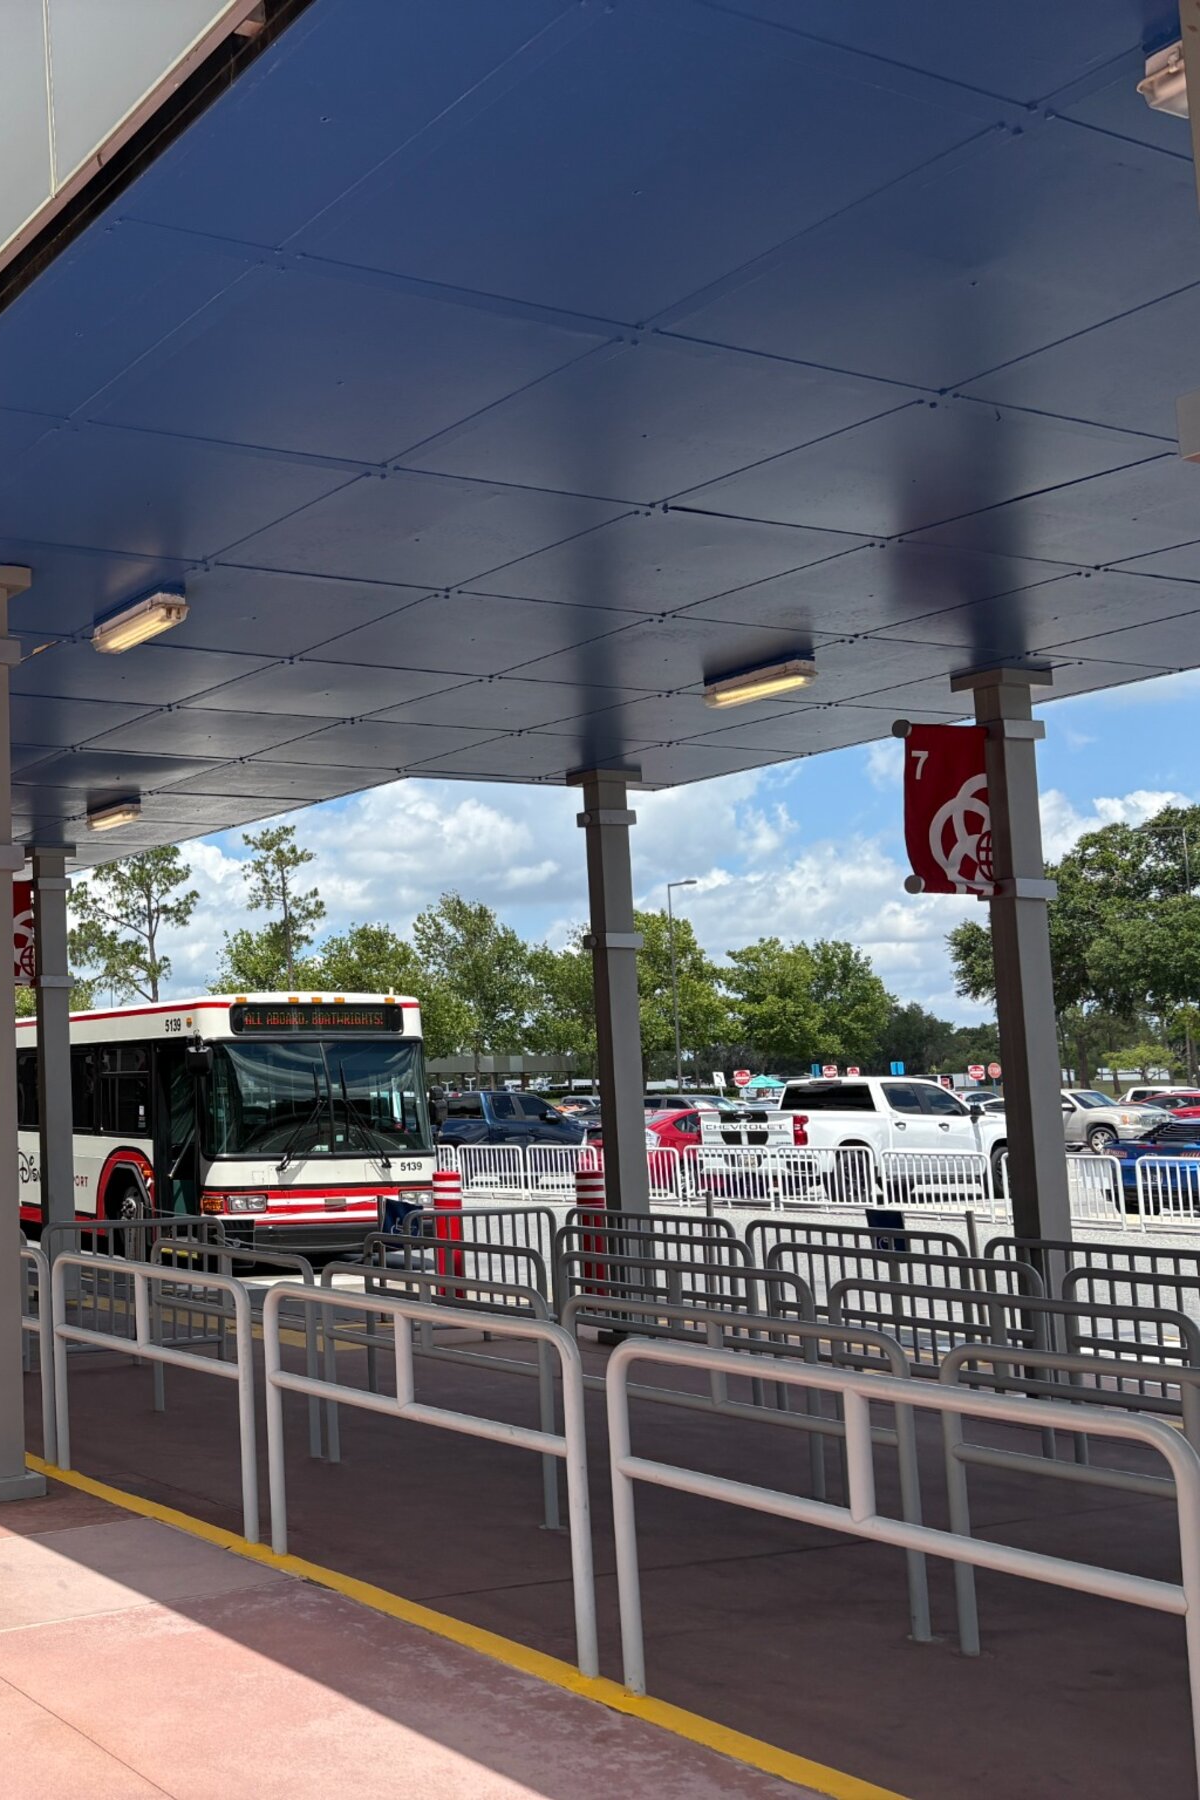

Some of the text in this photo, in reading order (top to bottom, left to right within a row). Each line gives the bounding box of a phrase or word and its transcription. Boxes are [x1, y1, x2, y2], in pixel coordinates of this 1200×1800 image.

[911, 750, 929, 780] 7
[165, 1017, 182, 1032] 5139
[245, 1011, 263, 1025] ALL
[706, 1123, 786, 1131] CHEVROLET
[400, 1161, 423, 1171] 5139
